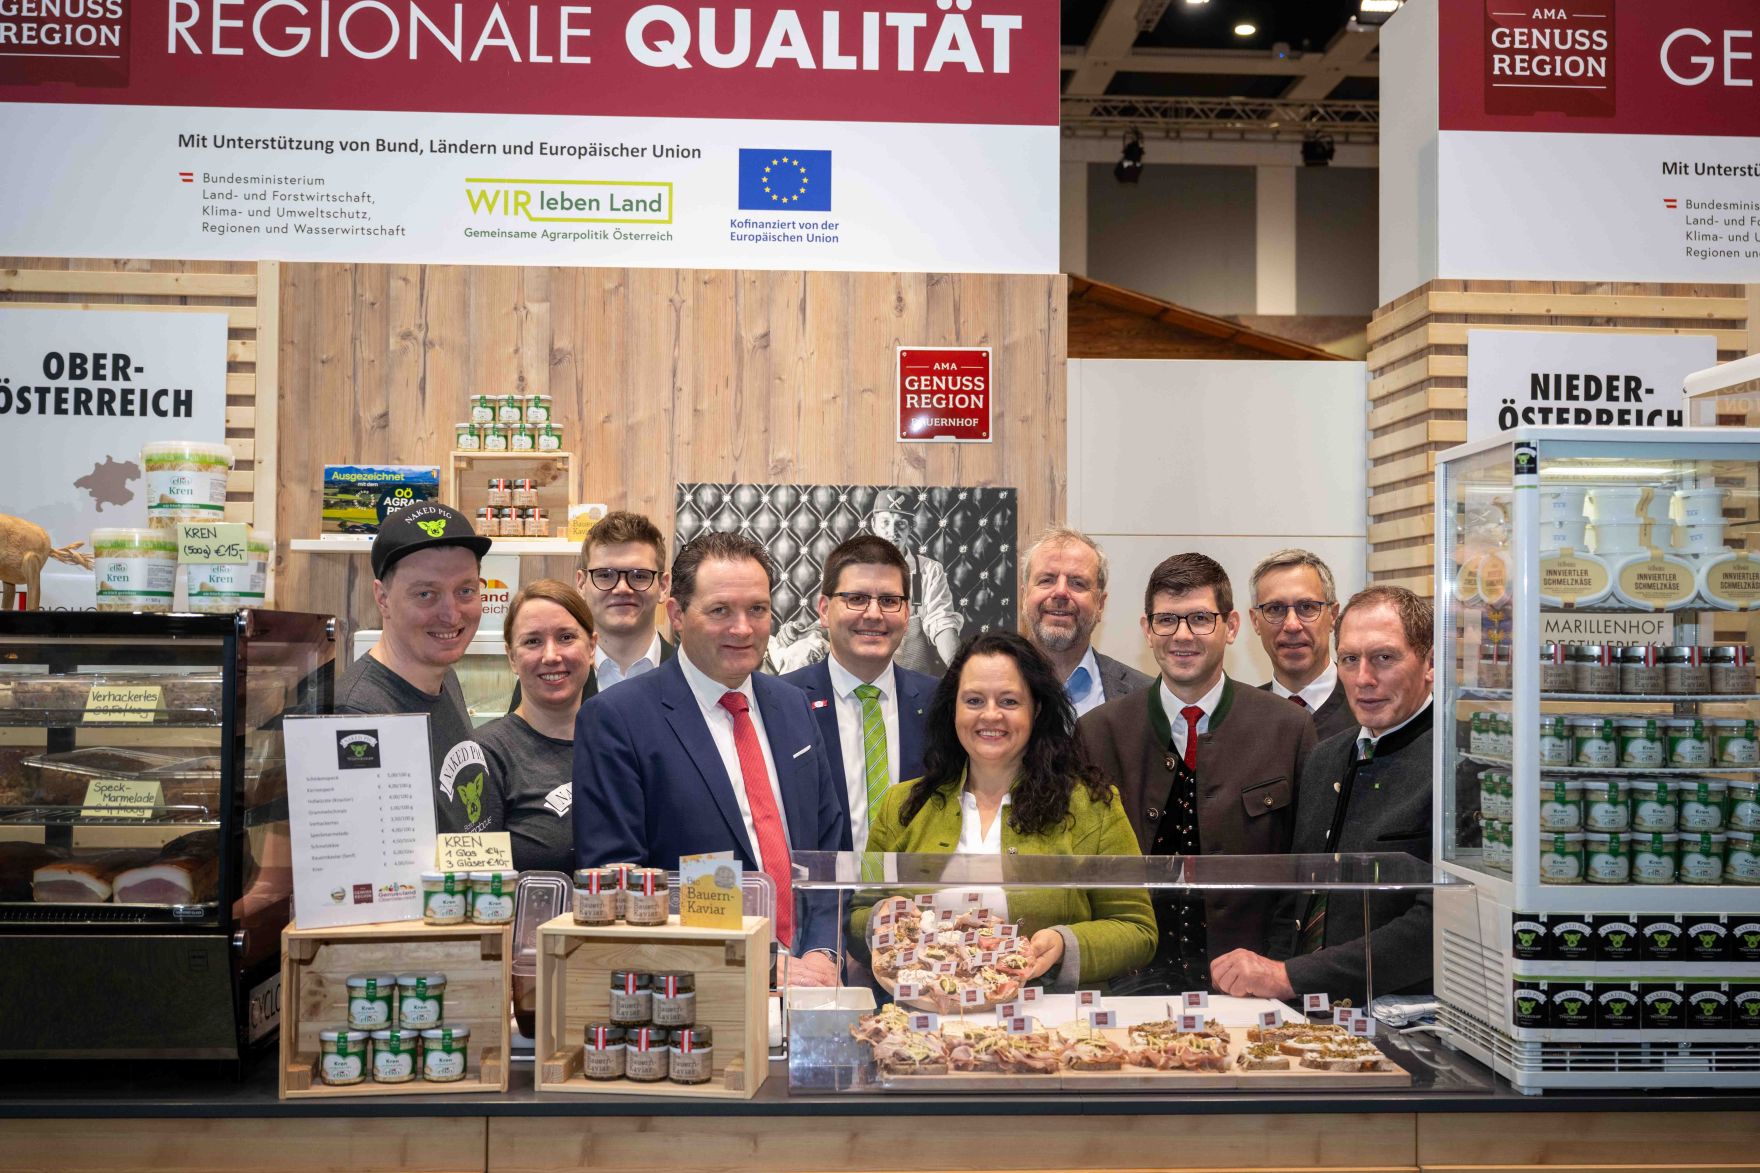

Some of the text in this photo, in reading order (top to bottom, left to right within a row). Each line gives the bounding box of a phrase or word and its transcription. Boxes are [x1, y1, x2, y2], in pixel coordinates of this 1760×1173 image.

[1532, 8, 1567, 19] AMA
[0, 23, 121, 46] REGION
[167, 0, 1022, 73] REGIONALE QUALITÄT
[1491, 27, 1608, 50] GENUSS
[1660, 27, 1753, 86] GE
[1492, 54, 1607, 77] REGION
[178, 134, 701, 159] Mit Unterstützung von Bund, Ländern und Europäischer Union
[1662, 162, 1689, 175] Mit
[203, 172, 325, 186] Bundesministerium
[202, 189, 376, 204] Land- und Forstwirtschaft,
[466, 189, 662, 216] WIR leben Land
[202, 205, 371, 221] Klima- und Umweltschutz,
[730, 218, 839, 230] Kofinanziert von der
[1685, 215, 1719, 226] Land-
[1723, 215, 1745, 226] und
[202, 222, 406, 236] Regionen und Wasserwirtschaft
[464, 227, 673, 241] Gemeinsame Agrarpolitik Österreich
[730, 231, 839, 244] Europäischen Union
[1685, 230, 1749, 242] Klima- und
[1686, 246, 1740, 260] Regionen
[43, 351, 144, 381] OBER-
[933, 362, 957, 370] AMA
[905, 376, 985, 391] GENUSS
[1530, 373, 1655, 403] NIEDER-
[0, 377, 193, 418] ÖSTERREICH
[905, 394, 984, 409] REGION
[332, 471, 405, 482] Ausgezeichnet
[168, 486, 193, 496] Kren
[395, 487, 413, 498] OÖ
[405, 506, 437, 524] NAKED
[184, 527, 217, 539] KREN
[106, 574, 129, 582] Kren
[208, 574, 233, 584] Kren
[1545, 568, 1589, 577] INNVIERTLER
[1636, 572, 1677, 582] INNVIERTLER
[1543, 577, 1592, 587] SCHMELZKÄSE
[1634, 581, 1680, 591] SCHMELZKÄSE
[1545, 619, 1665, 635] MARILLENHOF
[94, 782, 131, 794] Speck-
[102, 792, 155, 803] Marmelade
[444, 835, 483, 848] KREN
[445, 850, 452, 858] 1
[455, 848, 478, 857] Glas
[445, 859, 454, 869] 3
[687, 887, 734, 901] Bauern-
[687, 901, 726, 915] Kaviar
